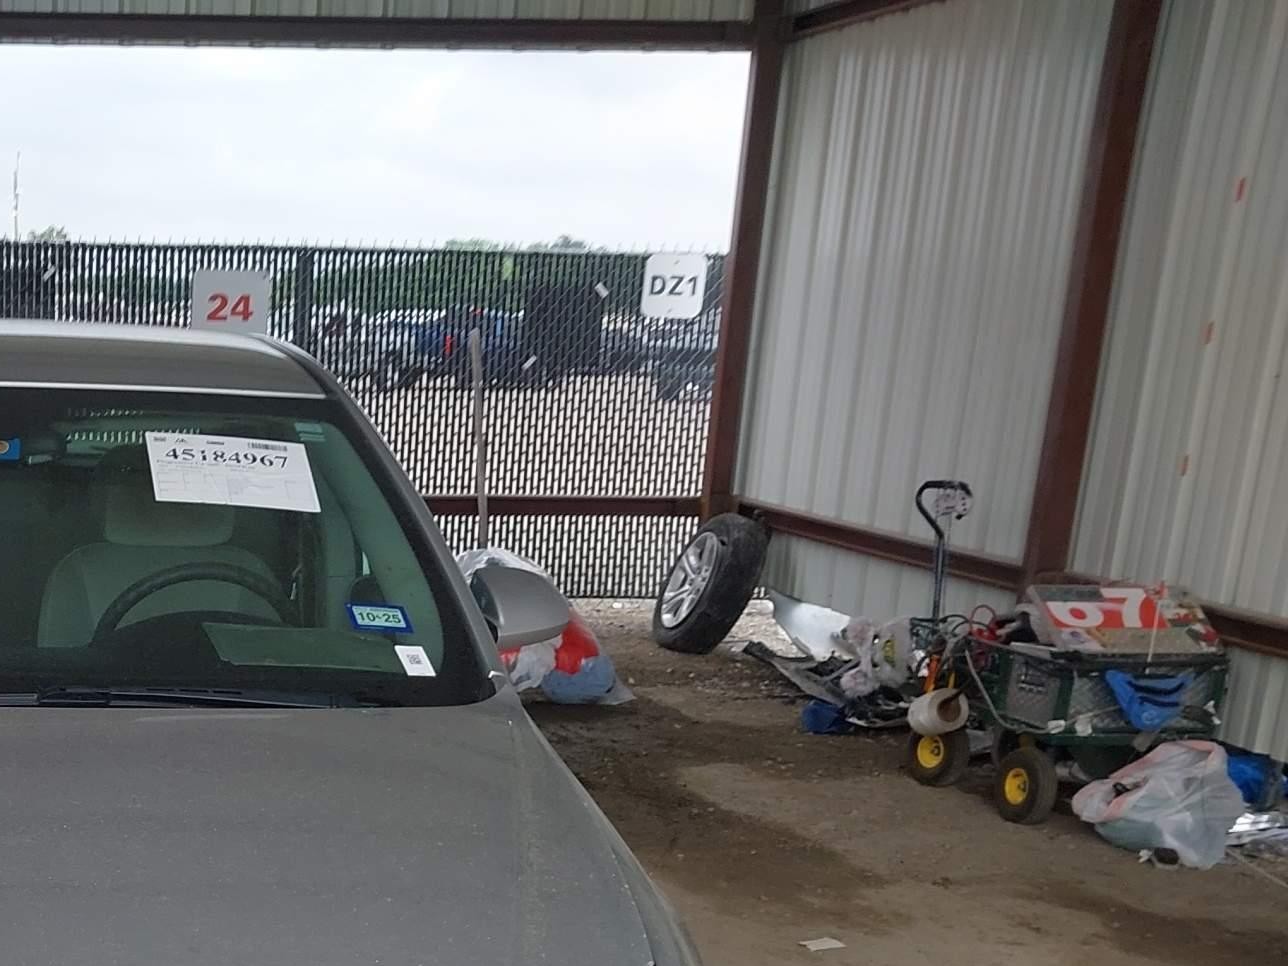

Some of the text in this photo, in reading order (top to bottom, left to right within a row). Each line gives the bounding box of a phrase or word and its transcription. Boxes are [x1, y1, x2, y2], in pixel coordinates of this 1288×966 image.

[648, 275, 698, 297] DZ1
[206, 292, 255, 322] 24
[165, 447, 289, 469] 45184967
